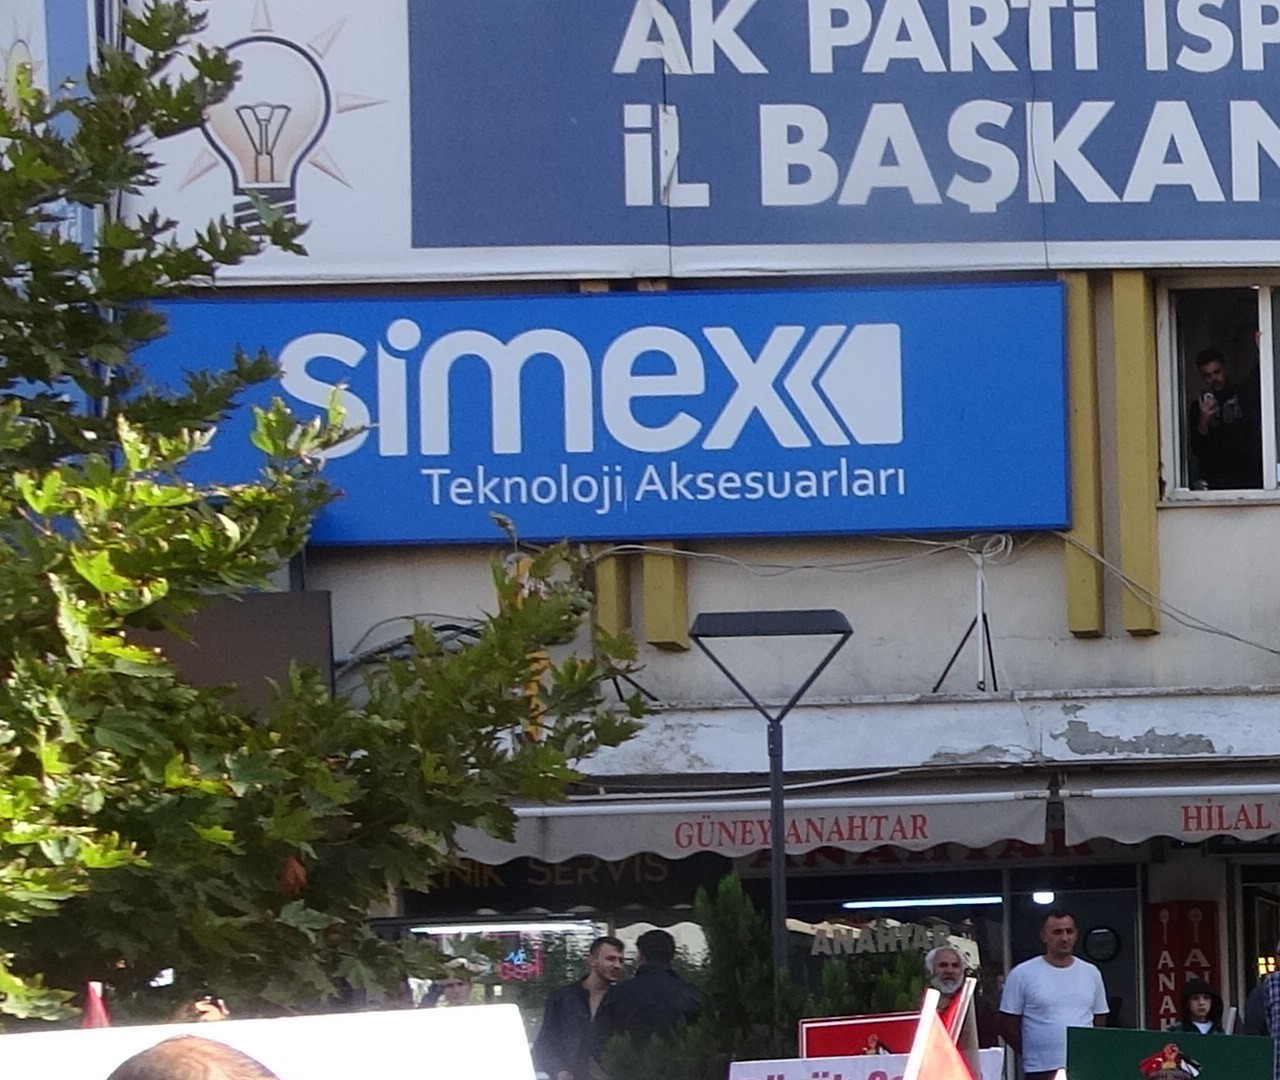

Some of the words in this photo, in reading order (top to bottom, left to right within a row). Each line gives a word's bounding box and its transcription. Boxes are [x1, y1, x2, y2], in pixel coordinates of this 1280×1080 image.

[613, 0, 771, 74] AK
[422, 463, 624, 515] Teknoloji
[636, 459, 906, 503] Aksesuarları
[675, 815, 771, 848] GÜNEY
[785, 813, 929, 844] ANAHTAR
[1181, 801, 1272, 832] HİLAL
